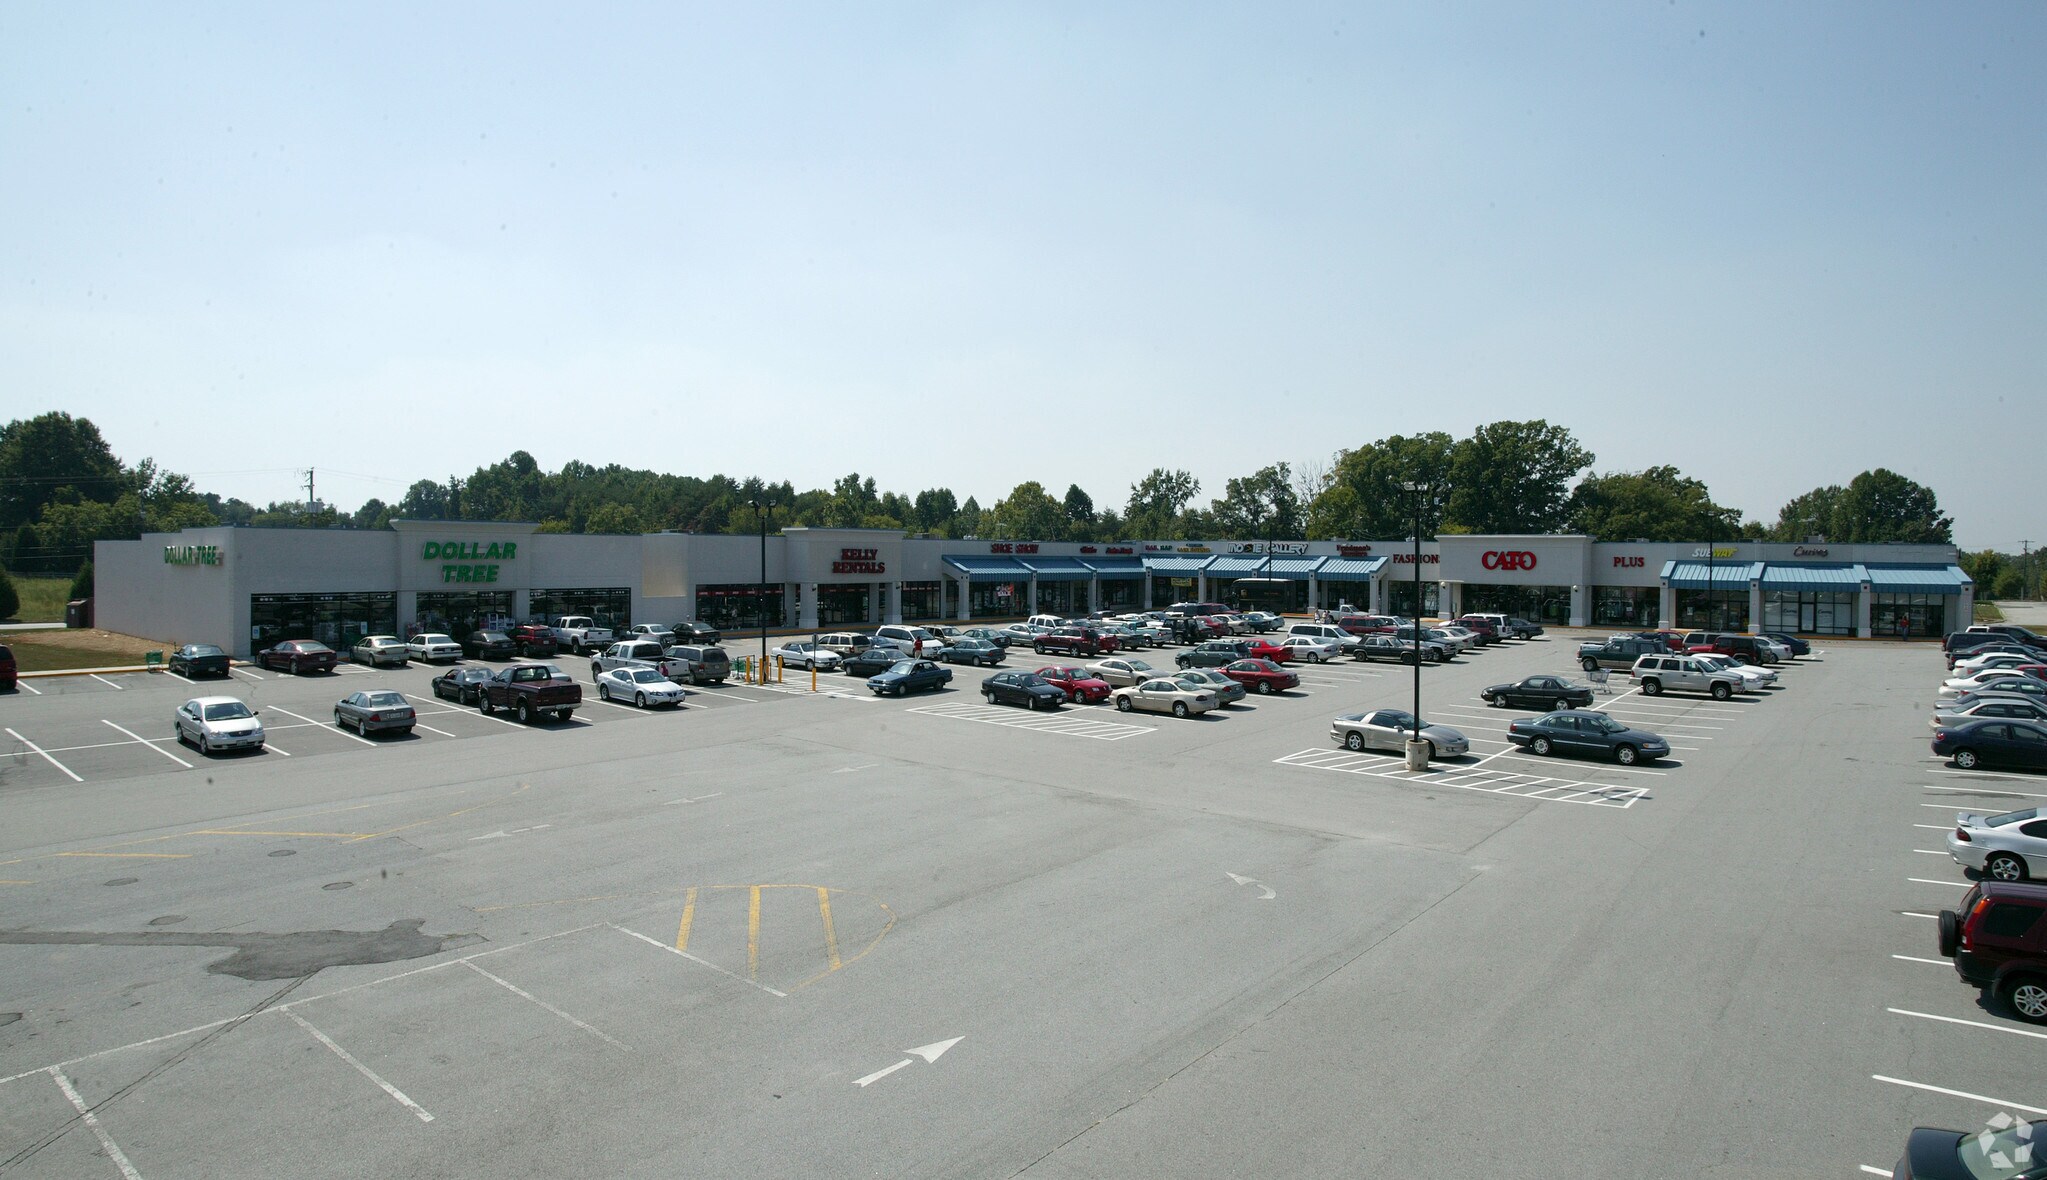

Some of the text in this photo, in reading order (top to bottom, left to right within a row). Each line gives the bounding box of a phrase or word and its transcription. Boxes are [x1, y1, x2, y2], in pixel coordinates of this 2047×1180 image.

[165, 545, 218, 565] DOLLAR TREE
[423, 542, 517, 560] DOLLAR
[841, 548, 879, 561] KELLY
[991, 543, 1039, 554] SHOE SHOW
[1266, 542, 1309, 556] GALLERY
[1692, 548, 1738, 558] SUBWAY
[1481, 550, 1537, 571] CATO
[1613, 556, 1645, 568] PLUS
[442, 564, 500, 583] TREE
[832, 561, 886, 574] RENTALS
